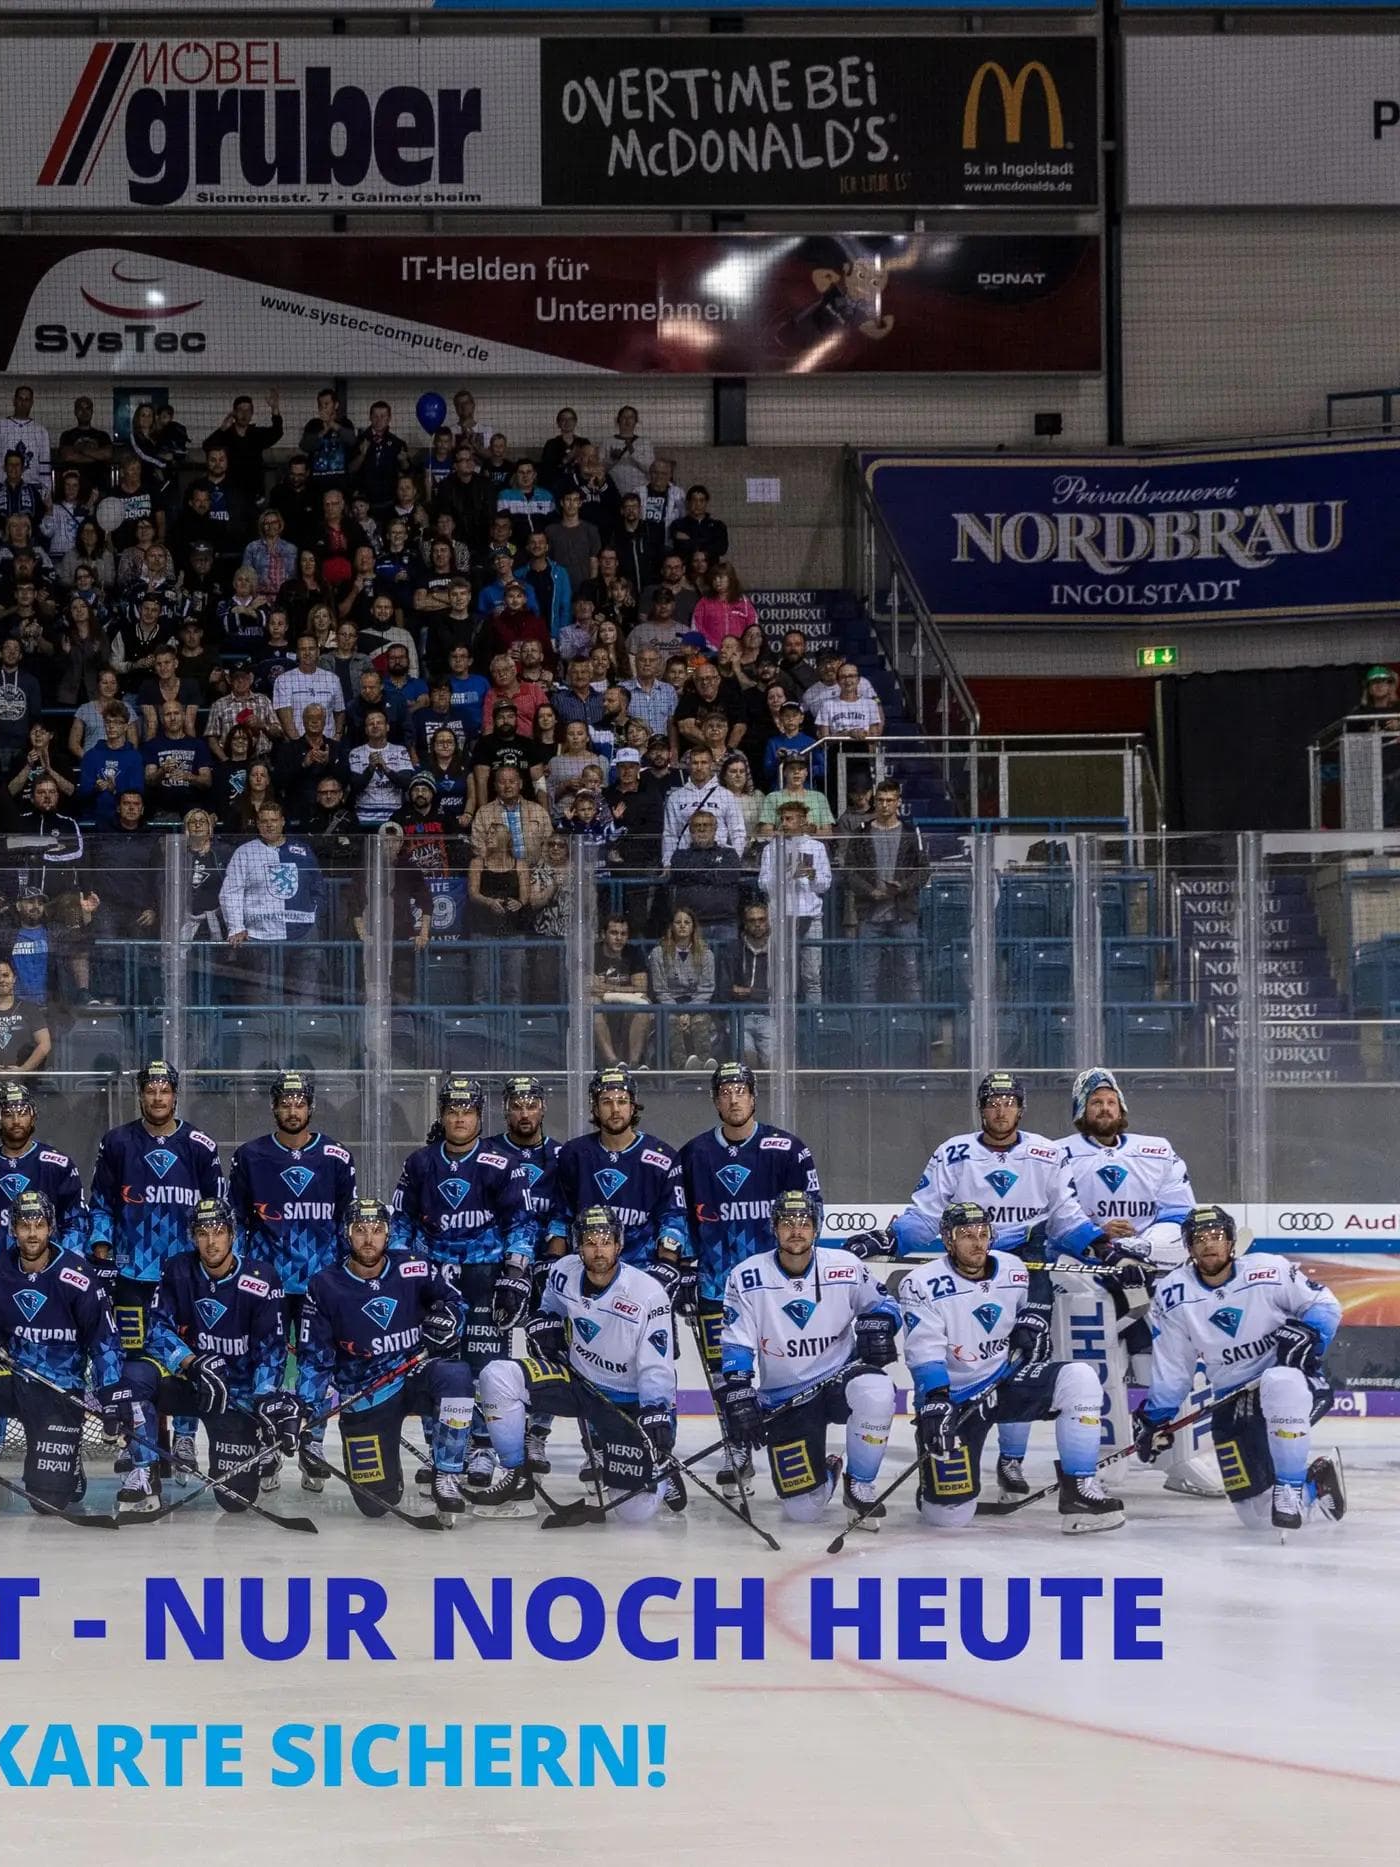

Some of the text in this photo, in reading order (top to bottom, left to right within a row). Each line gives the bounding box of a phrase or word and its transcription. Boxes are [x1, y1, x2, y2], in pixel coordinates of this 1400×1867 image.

[131, 41, 296, 85] MÖBEL
[124, 66, 482, 206] gruber
[963, 162, 1074, 178] 5x in Ingolstadt
[318, 191, 329, 203] 7
[963, 181, 1073, 193] www.mcdonalds.de
[400, 257, 589, 282] IT-Helden für
[977, 273, 1046, 285] DONAT
[535, 297, 740, 322] Unternehmen
[259, 293, 490, 363] www.systec-computer.de
[33, 322, 207, 359] SysTec
[1050, 474, 1238, 507] Privatbrauerei
[950, 500, 1348, 575] NORDBRÄU
[1050, 579, 1241, 605] INGOLSTADT
[945, 1143, 971, 1164] 22
[1344, 1213, 1400, 1230] Aud
[741, 1268, 763, 1289] 61
[927, 1275, 957, 1298] 23
[1161, 1283, 1185, 1307] 27
[36, 1441, 77, 1456] HERRN
[37, 1458, 72, 1473] BRÄU
[608, 1461, 644, 1477] BRÄU
